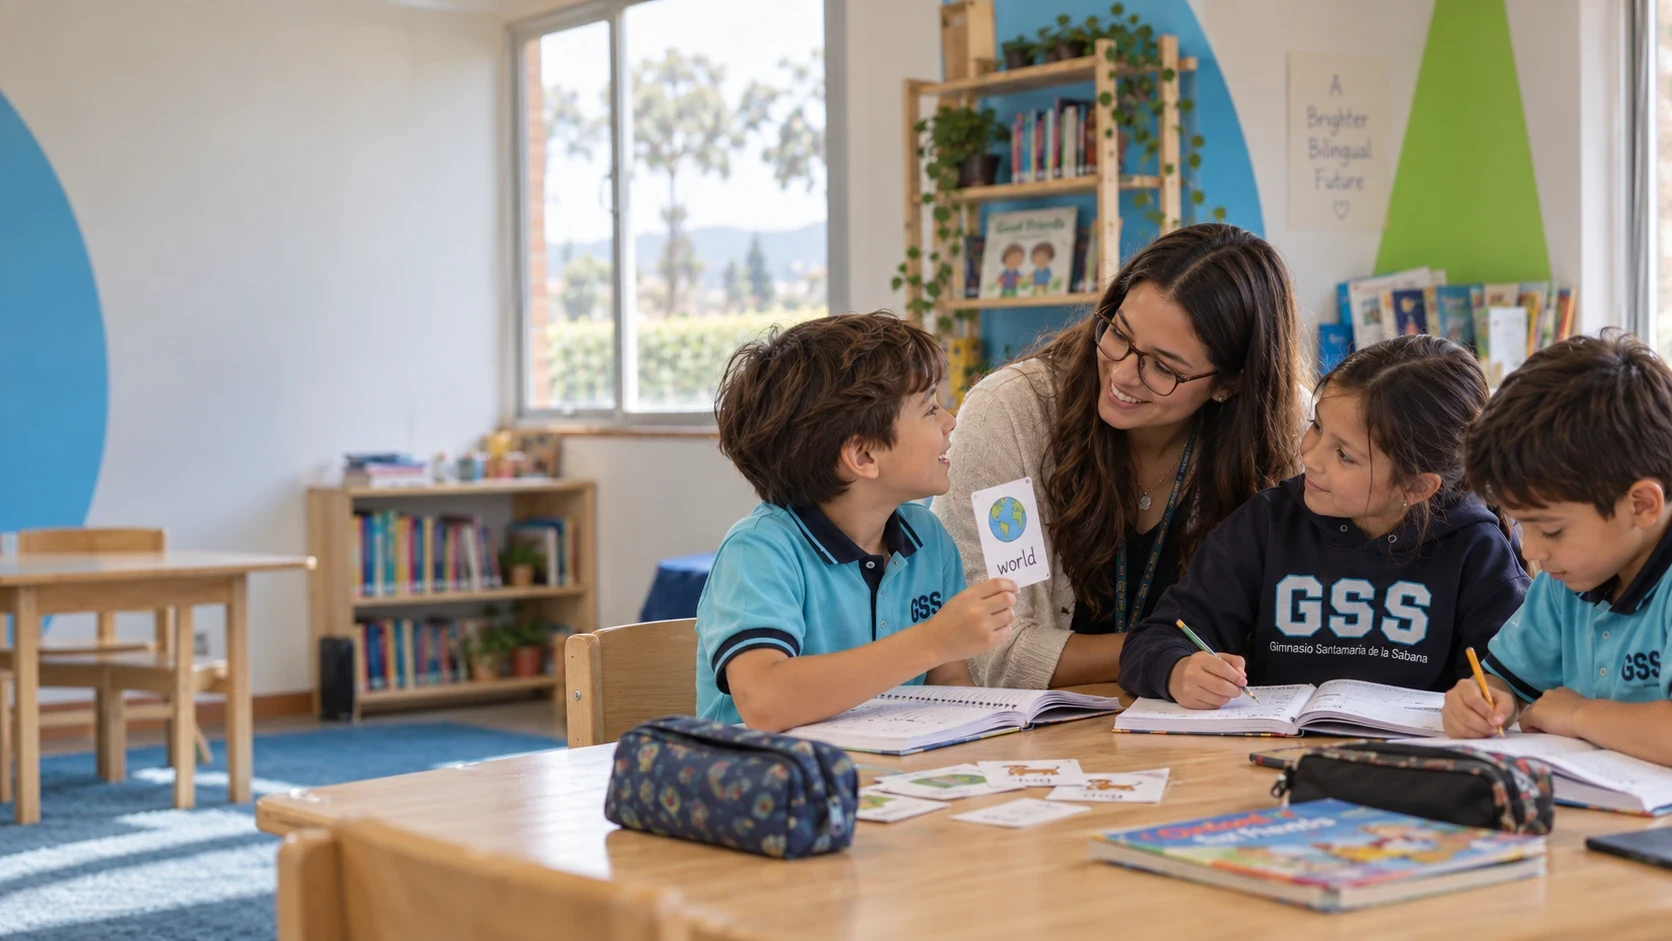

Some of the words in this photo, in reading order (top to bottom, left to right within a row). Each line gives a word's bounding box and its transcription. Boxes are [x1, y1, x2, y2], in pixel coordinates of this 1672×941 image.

[1329, 73, 1343, 97] A
[1306, 104, 1369, 137] Brighter
[1308, 137, 1372, 167] Bilingual
[1314, 167, 1365, 190] Future
[997, 546, 1037, 575] world
[911, 591, 943, 623] GSS
[1275, 574, 1432, 646] GSS
[1269, 641, 1314, 654] Gimnasio
[1368, 645, 1379, 656] de
[1381, 646, 1389, 658] la
[1391, 648, 1428, 664] Sabana
[1621, 650, 1661, 682] GSS
